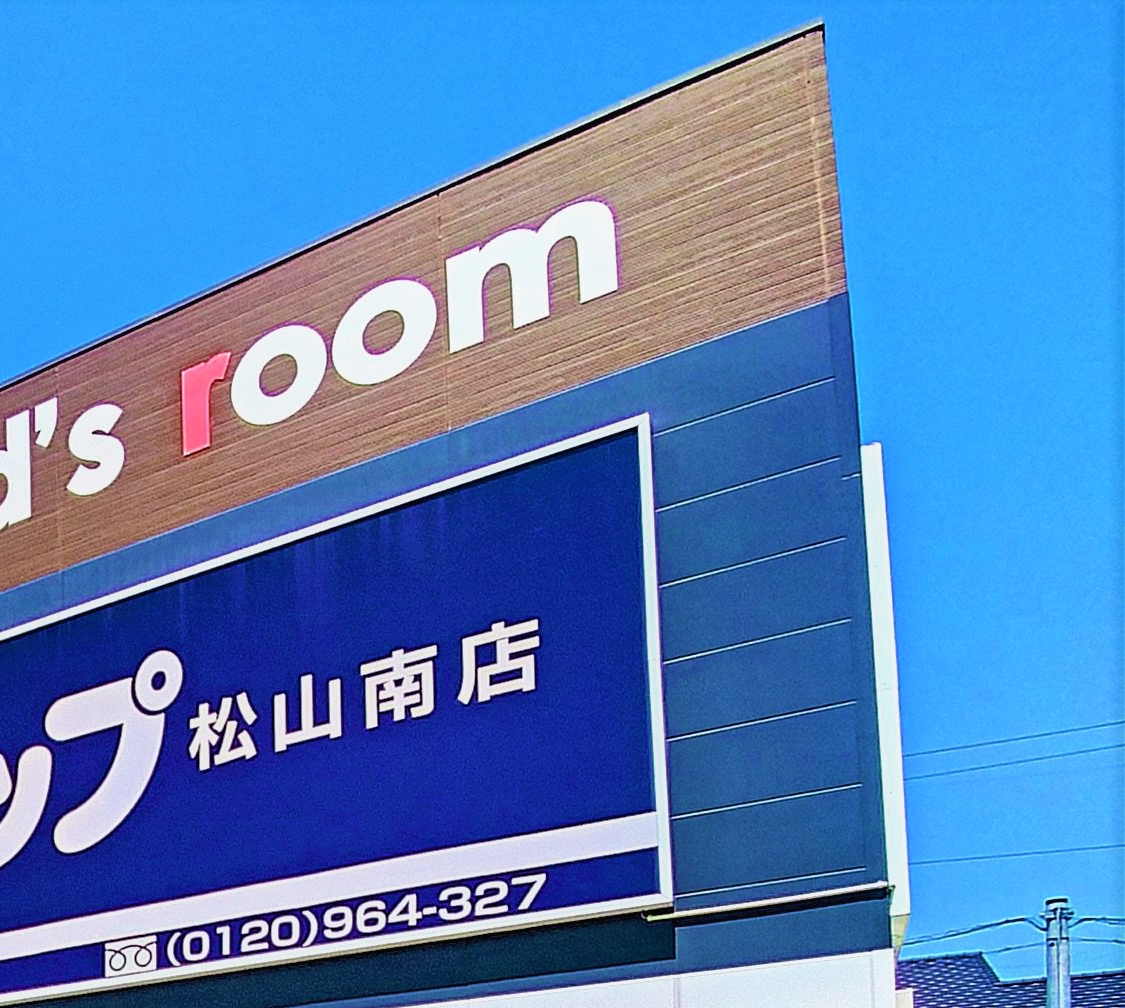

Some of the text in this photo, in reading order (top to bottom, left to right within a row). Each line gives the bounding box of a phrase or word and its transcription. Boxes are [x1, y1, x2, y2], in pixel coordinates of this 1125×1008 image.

[180, 199, 620, 458] room
[188, 617, 541, 772] 松山南店
[166, 872, 548, 967] (0120)964-327
